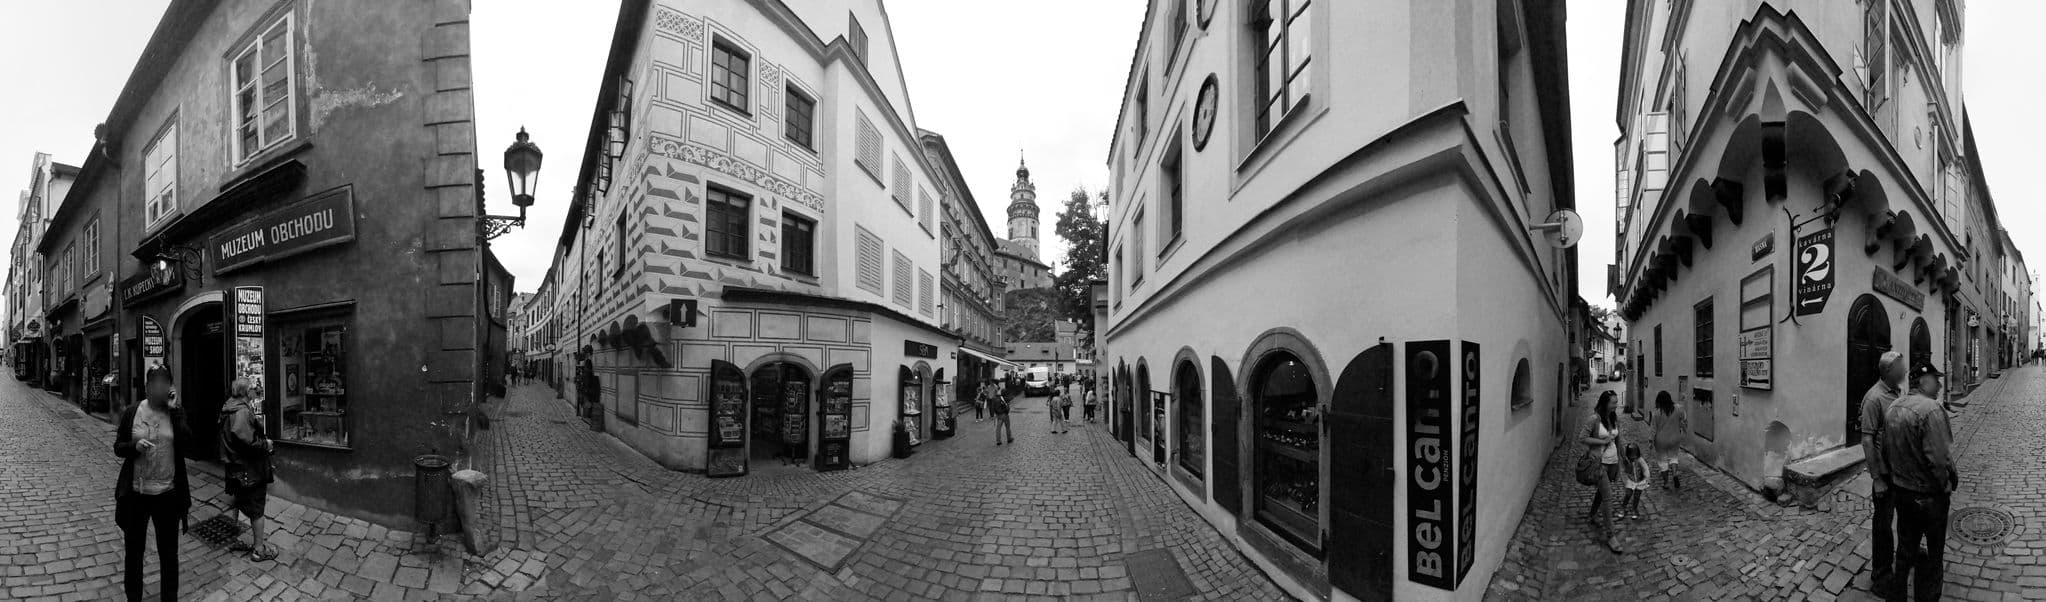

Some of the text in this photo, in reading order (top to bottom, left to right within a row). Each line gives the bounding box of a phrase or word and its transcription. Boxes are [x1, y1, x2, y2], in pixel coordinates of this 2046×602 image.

[221, 208, 333, 260] MUZEUM OBCHODU
[1799, 232, 1832, 248] kavárna
[1801, 243, 1830, 284] 2
[1798, 282, 1832, 295] vinárna
[238, 289, 261, 303] MUZEUM
[238, 303, 261, 315] OBCHODU
[238, 324, 261, 332] KRUMLOV
[149, 345, 162, 354] SHOP
